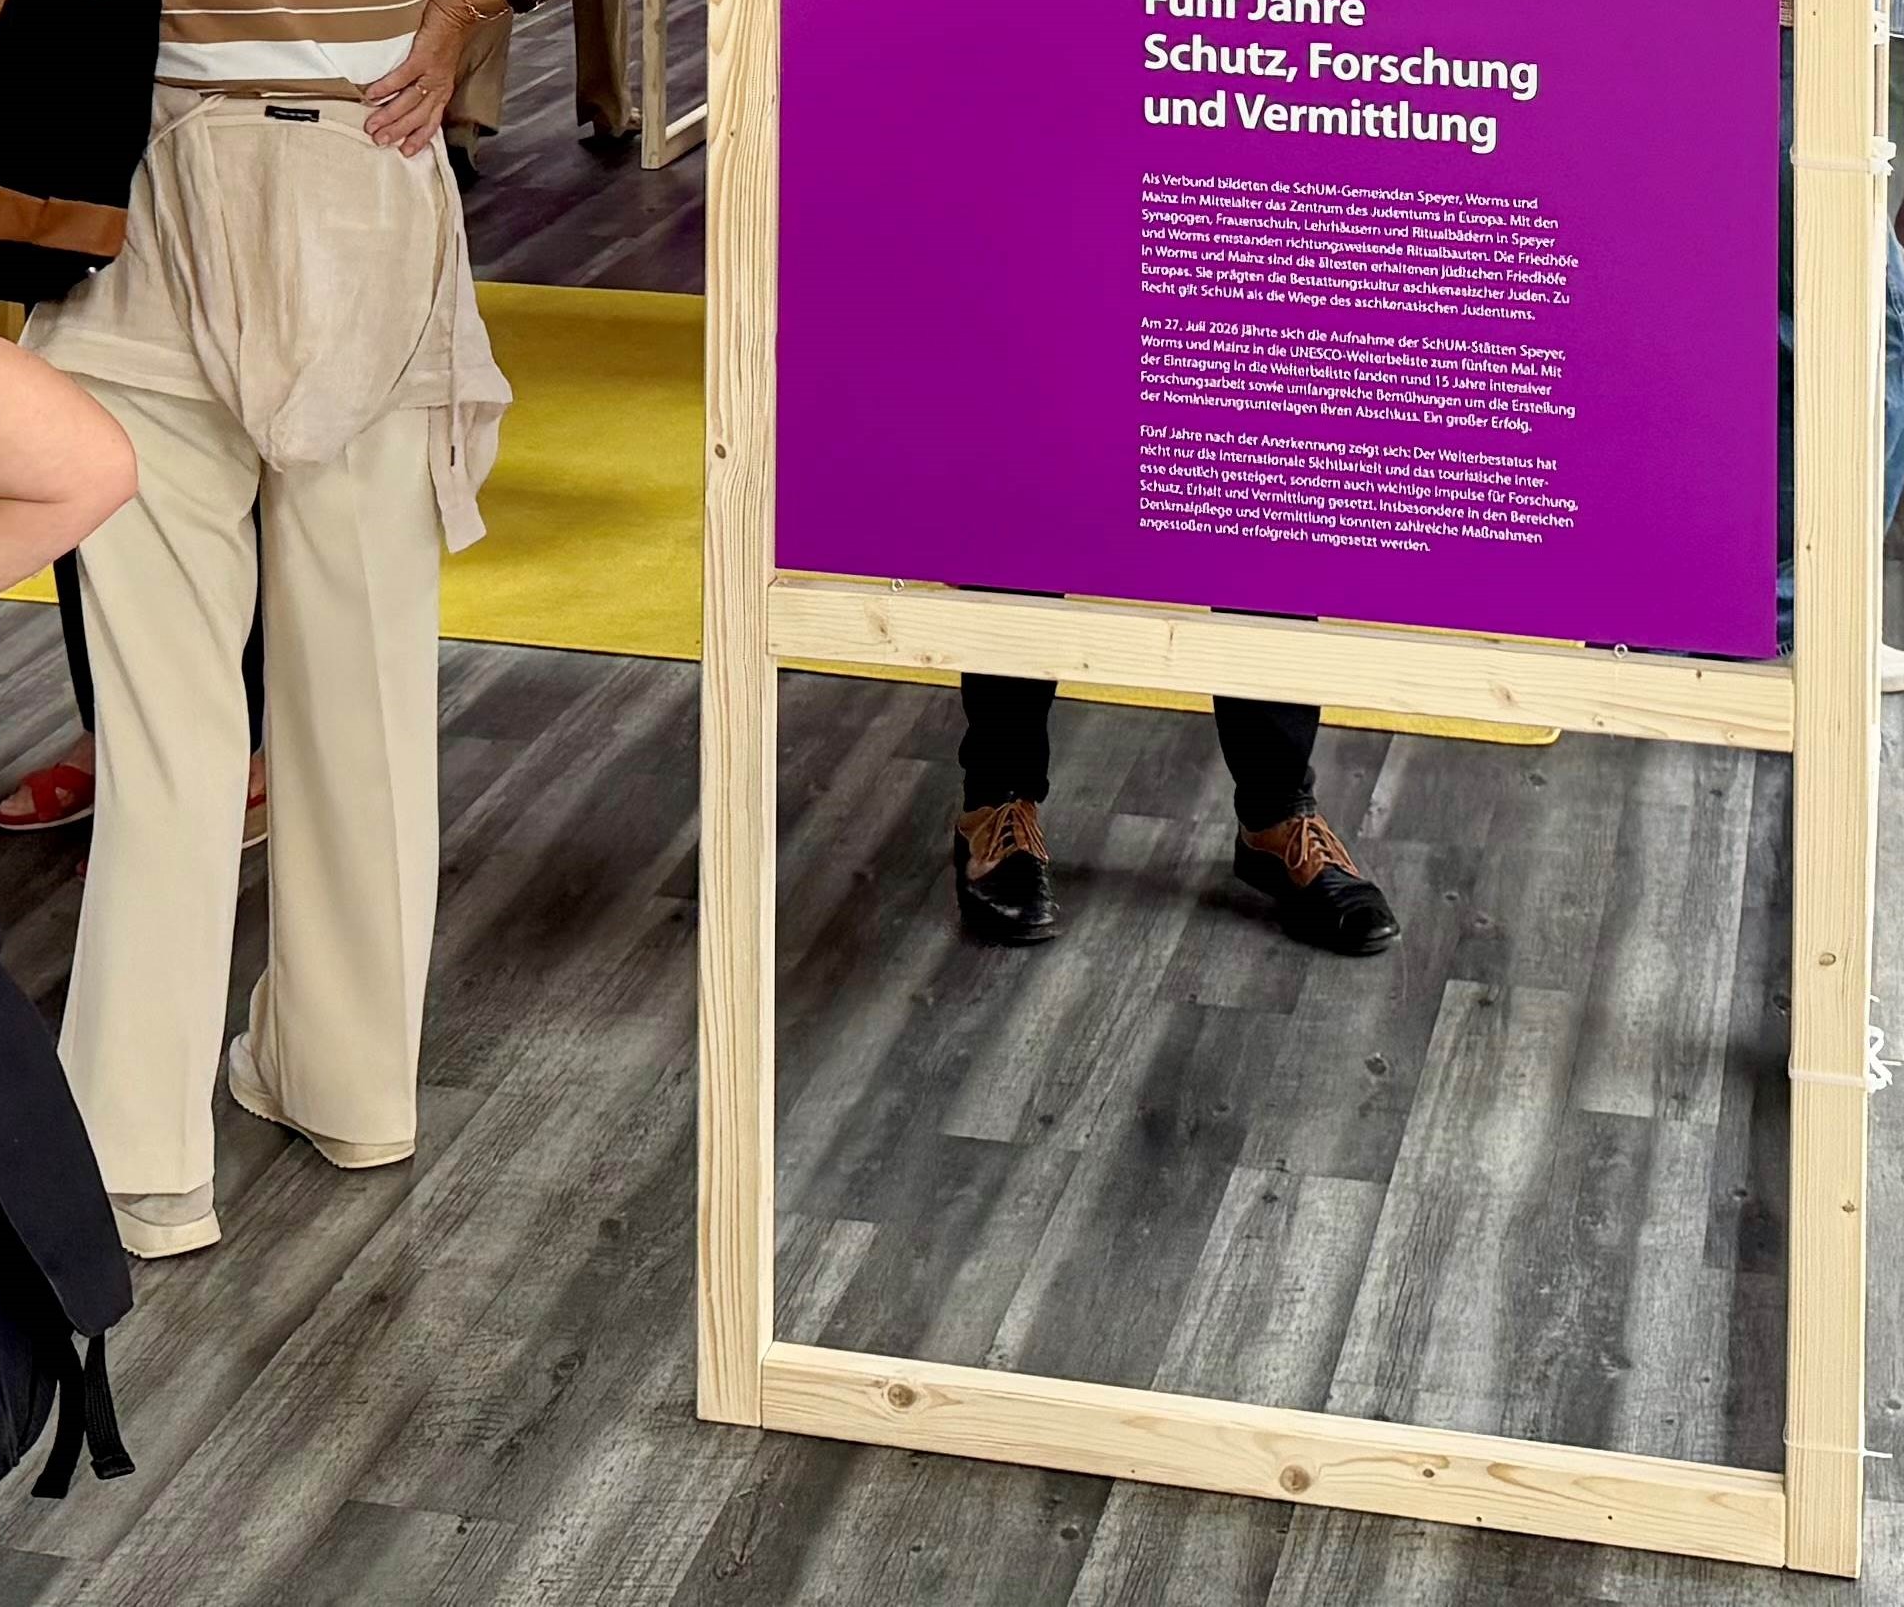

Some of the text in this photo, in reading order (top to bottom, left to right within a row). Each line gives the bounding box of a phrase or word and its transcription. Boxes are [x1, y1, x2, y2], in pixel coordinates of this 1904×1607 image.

[1144, 33, 1538, 101] Schutz, Forschung
[1144, 89, 1497, 154] und Vermittlung
